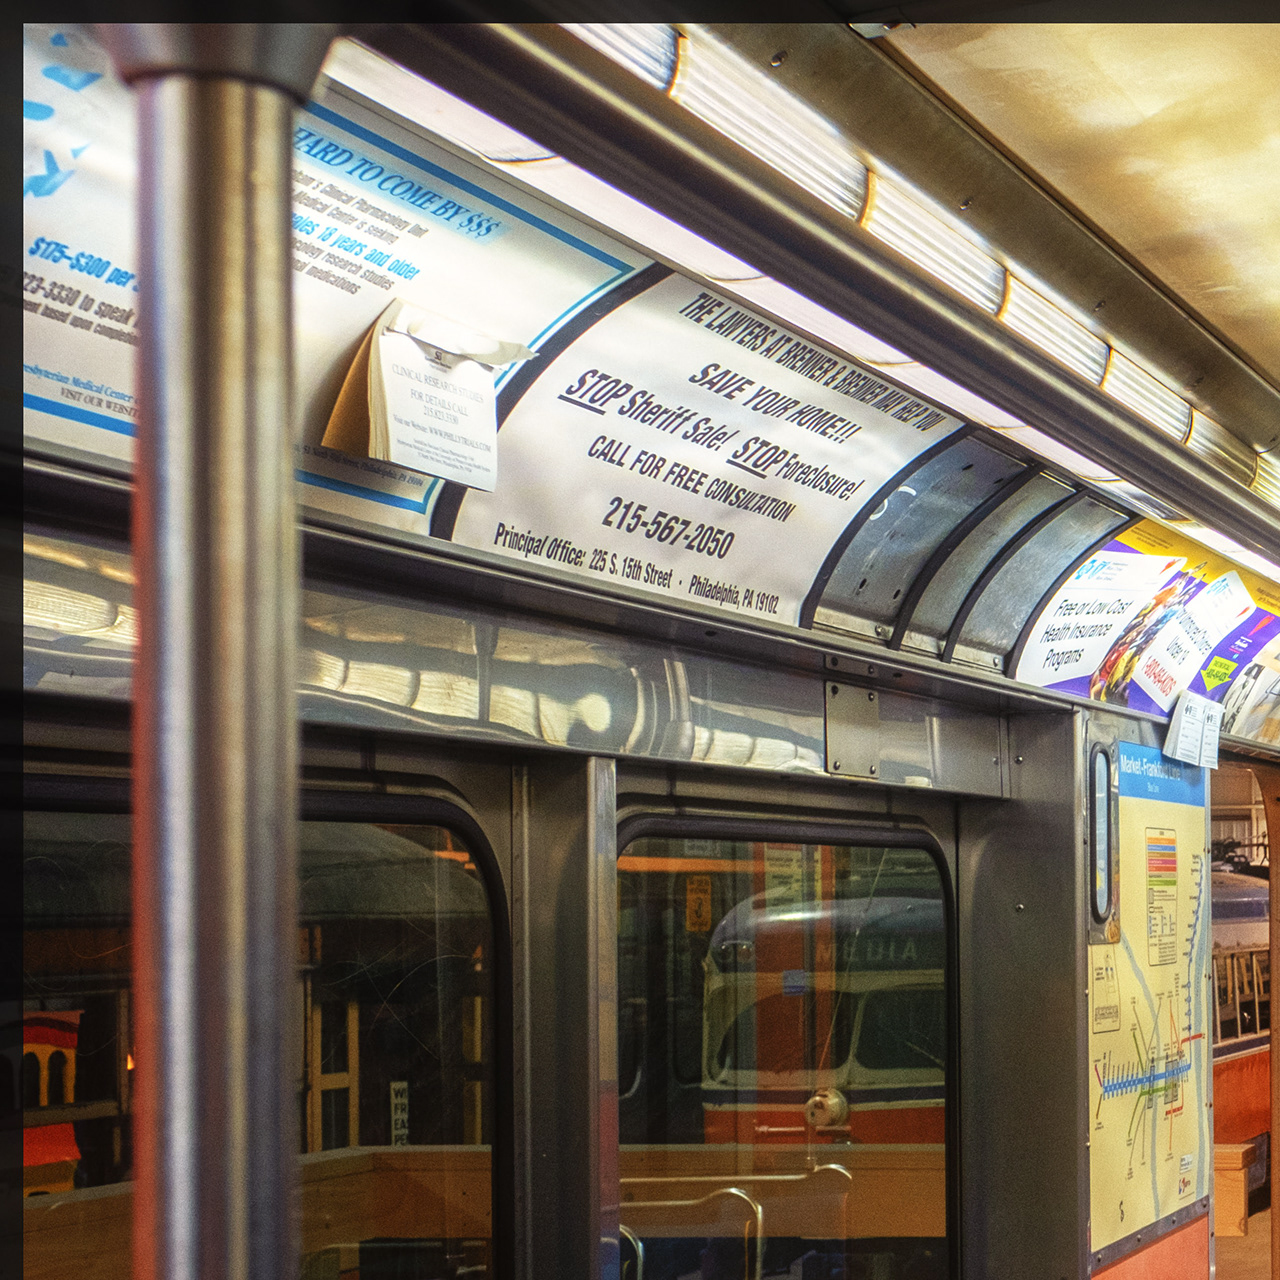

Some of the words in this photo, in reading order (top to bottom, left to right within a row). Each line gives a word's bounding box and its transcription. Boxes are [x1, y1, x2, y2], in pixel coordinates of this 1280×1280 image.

[293, 126, 354, 168] HARD
[346, 157, 384, 183] TO
[377, 173, 443, 211] COME
[430, 200, 470, 223] BY
[458, 211, 502, 239] $$$
[317, 225, 339, 243] 18
[328, 233, 368, 257] years
[364, 247, 394, 269] and
[387, 258, 421, 282] older
[93, 301, 135, 327] speak
[678, 291, 726, 324] THE
[703, 305, 779, 353] LAWYERS
[759, 330, 790, 360] AT
[775, 336, 841, 387] BRENNER
[822, 364, 848, 387] &
[871, 388, 906, 414] MAY
[889, 396, 930, 424] HELP
[913, 411, 948, 433] YOU
[566, 368, 635, 408] STOP
[616, 389, 699, 436] Sheriff
[681, 415, 741, 452] Sale!
[731, 435, 791, 474] STOP
[774, 450, 867, 502] Foreclosure!
[687, 362, 755, 401] SAVE
[741, 384, 802, 420] YOUR
[785, 402, 863, 445] HOME!!!
[586, 434, 633, 468] CALL
[628, 448, 669, 480] FOR
[661, 460, 710, 495] FREE
[703, 476, 798, 524] CONSULTATION
[600, 495, 737, 560] 215-567-2050
[493, 521, 549, 559] Principal
[546, 536, 587, 568] Office:
[588, 548, 609, 574] 225
[608, 552, 619, 576] S.
[620, 556, 643, 582] 15th
[642, 561, 674, 589] Street
[688, 574, 742, 611] Philadelphia,
[741, 587, 755, 609] PA
[754, 591, 780, 615] 19102
[1040, 622, 1071, 644] Health
[1067, 622, 1114, 640] Insurance
[1052, 598, 1077, 618] Free
[1086, 598, 1108, 616] Low
[1105, 598, 1136, 616] Cost
[1042, 648, 1085, 673] Programs
